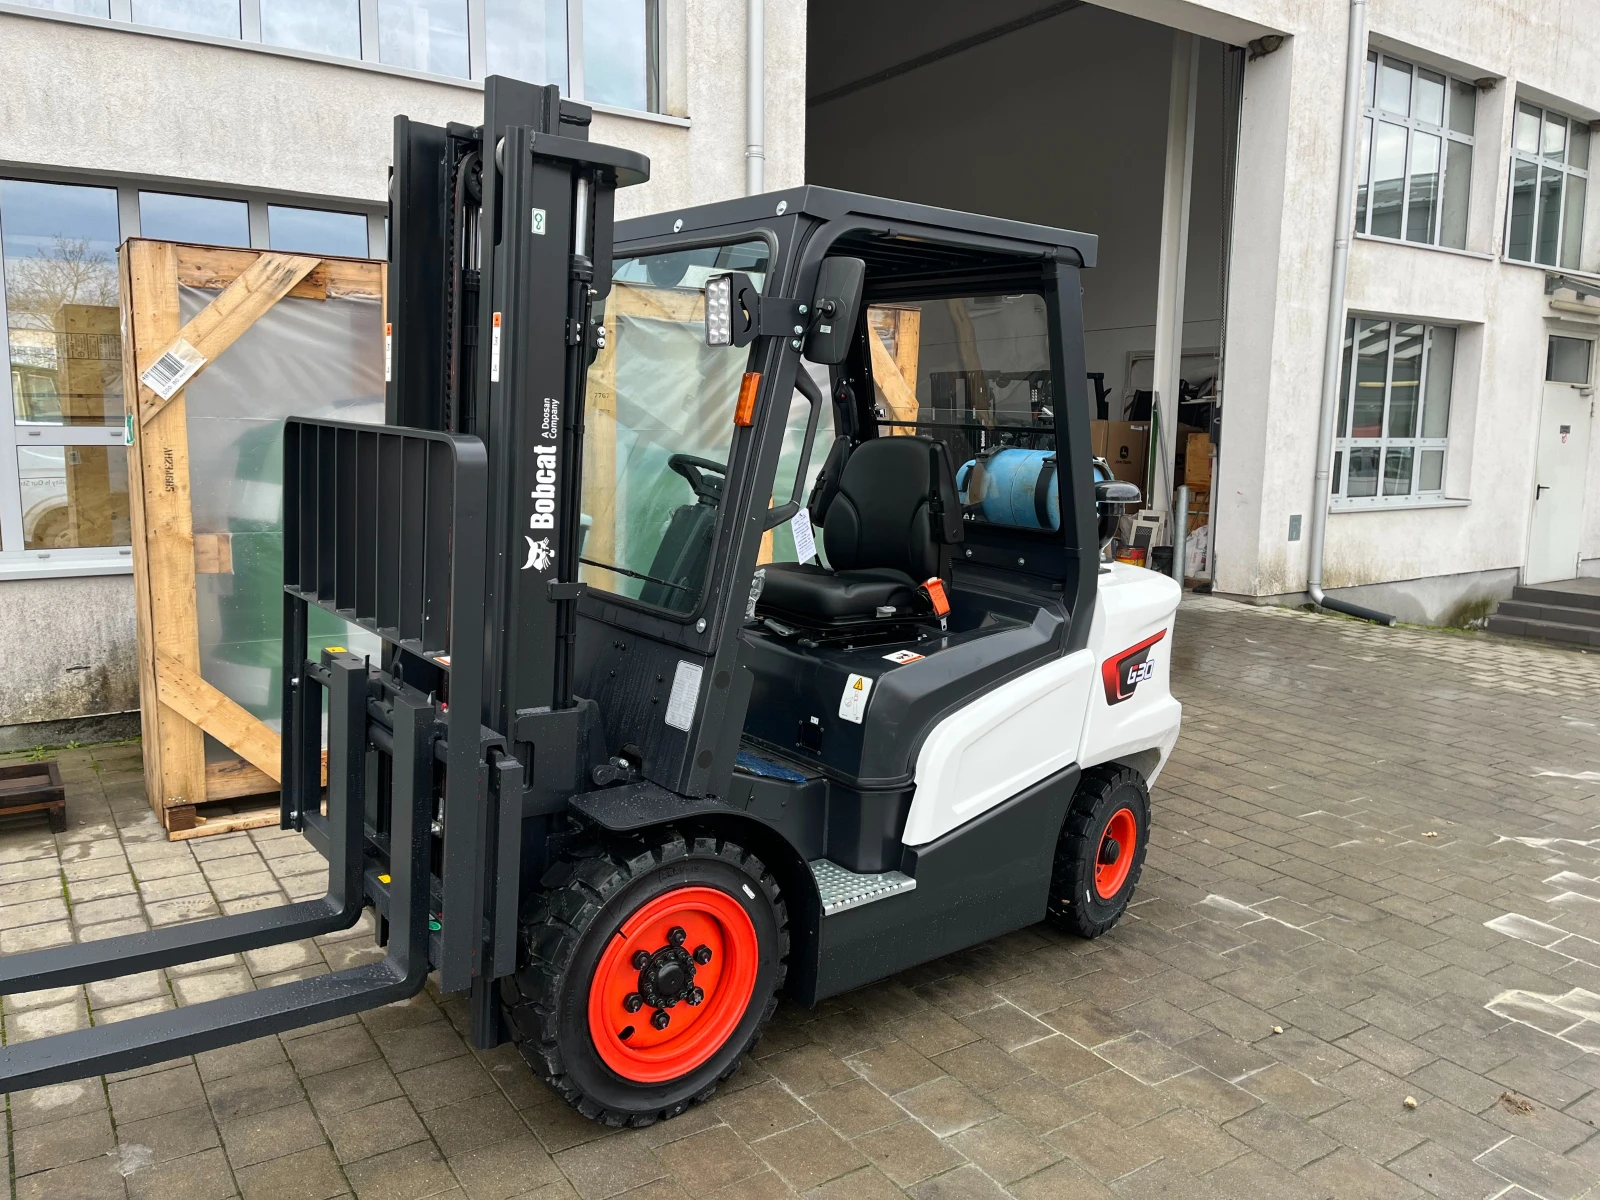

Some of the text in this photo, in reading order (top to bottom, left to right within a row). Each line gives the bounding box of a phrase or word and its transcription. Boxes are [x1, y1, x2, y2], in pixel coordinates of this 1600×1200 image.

[541, 397, 551, 439] A Doosan
[548, 398, 560, 439] Company
[530, 444, 557, 529] Bobcat
[1127, 659, 1155, 685] G30
